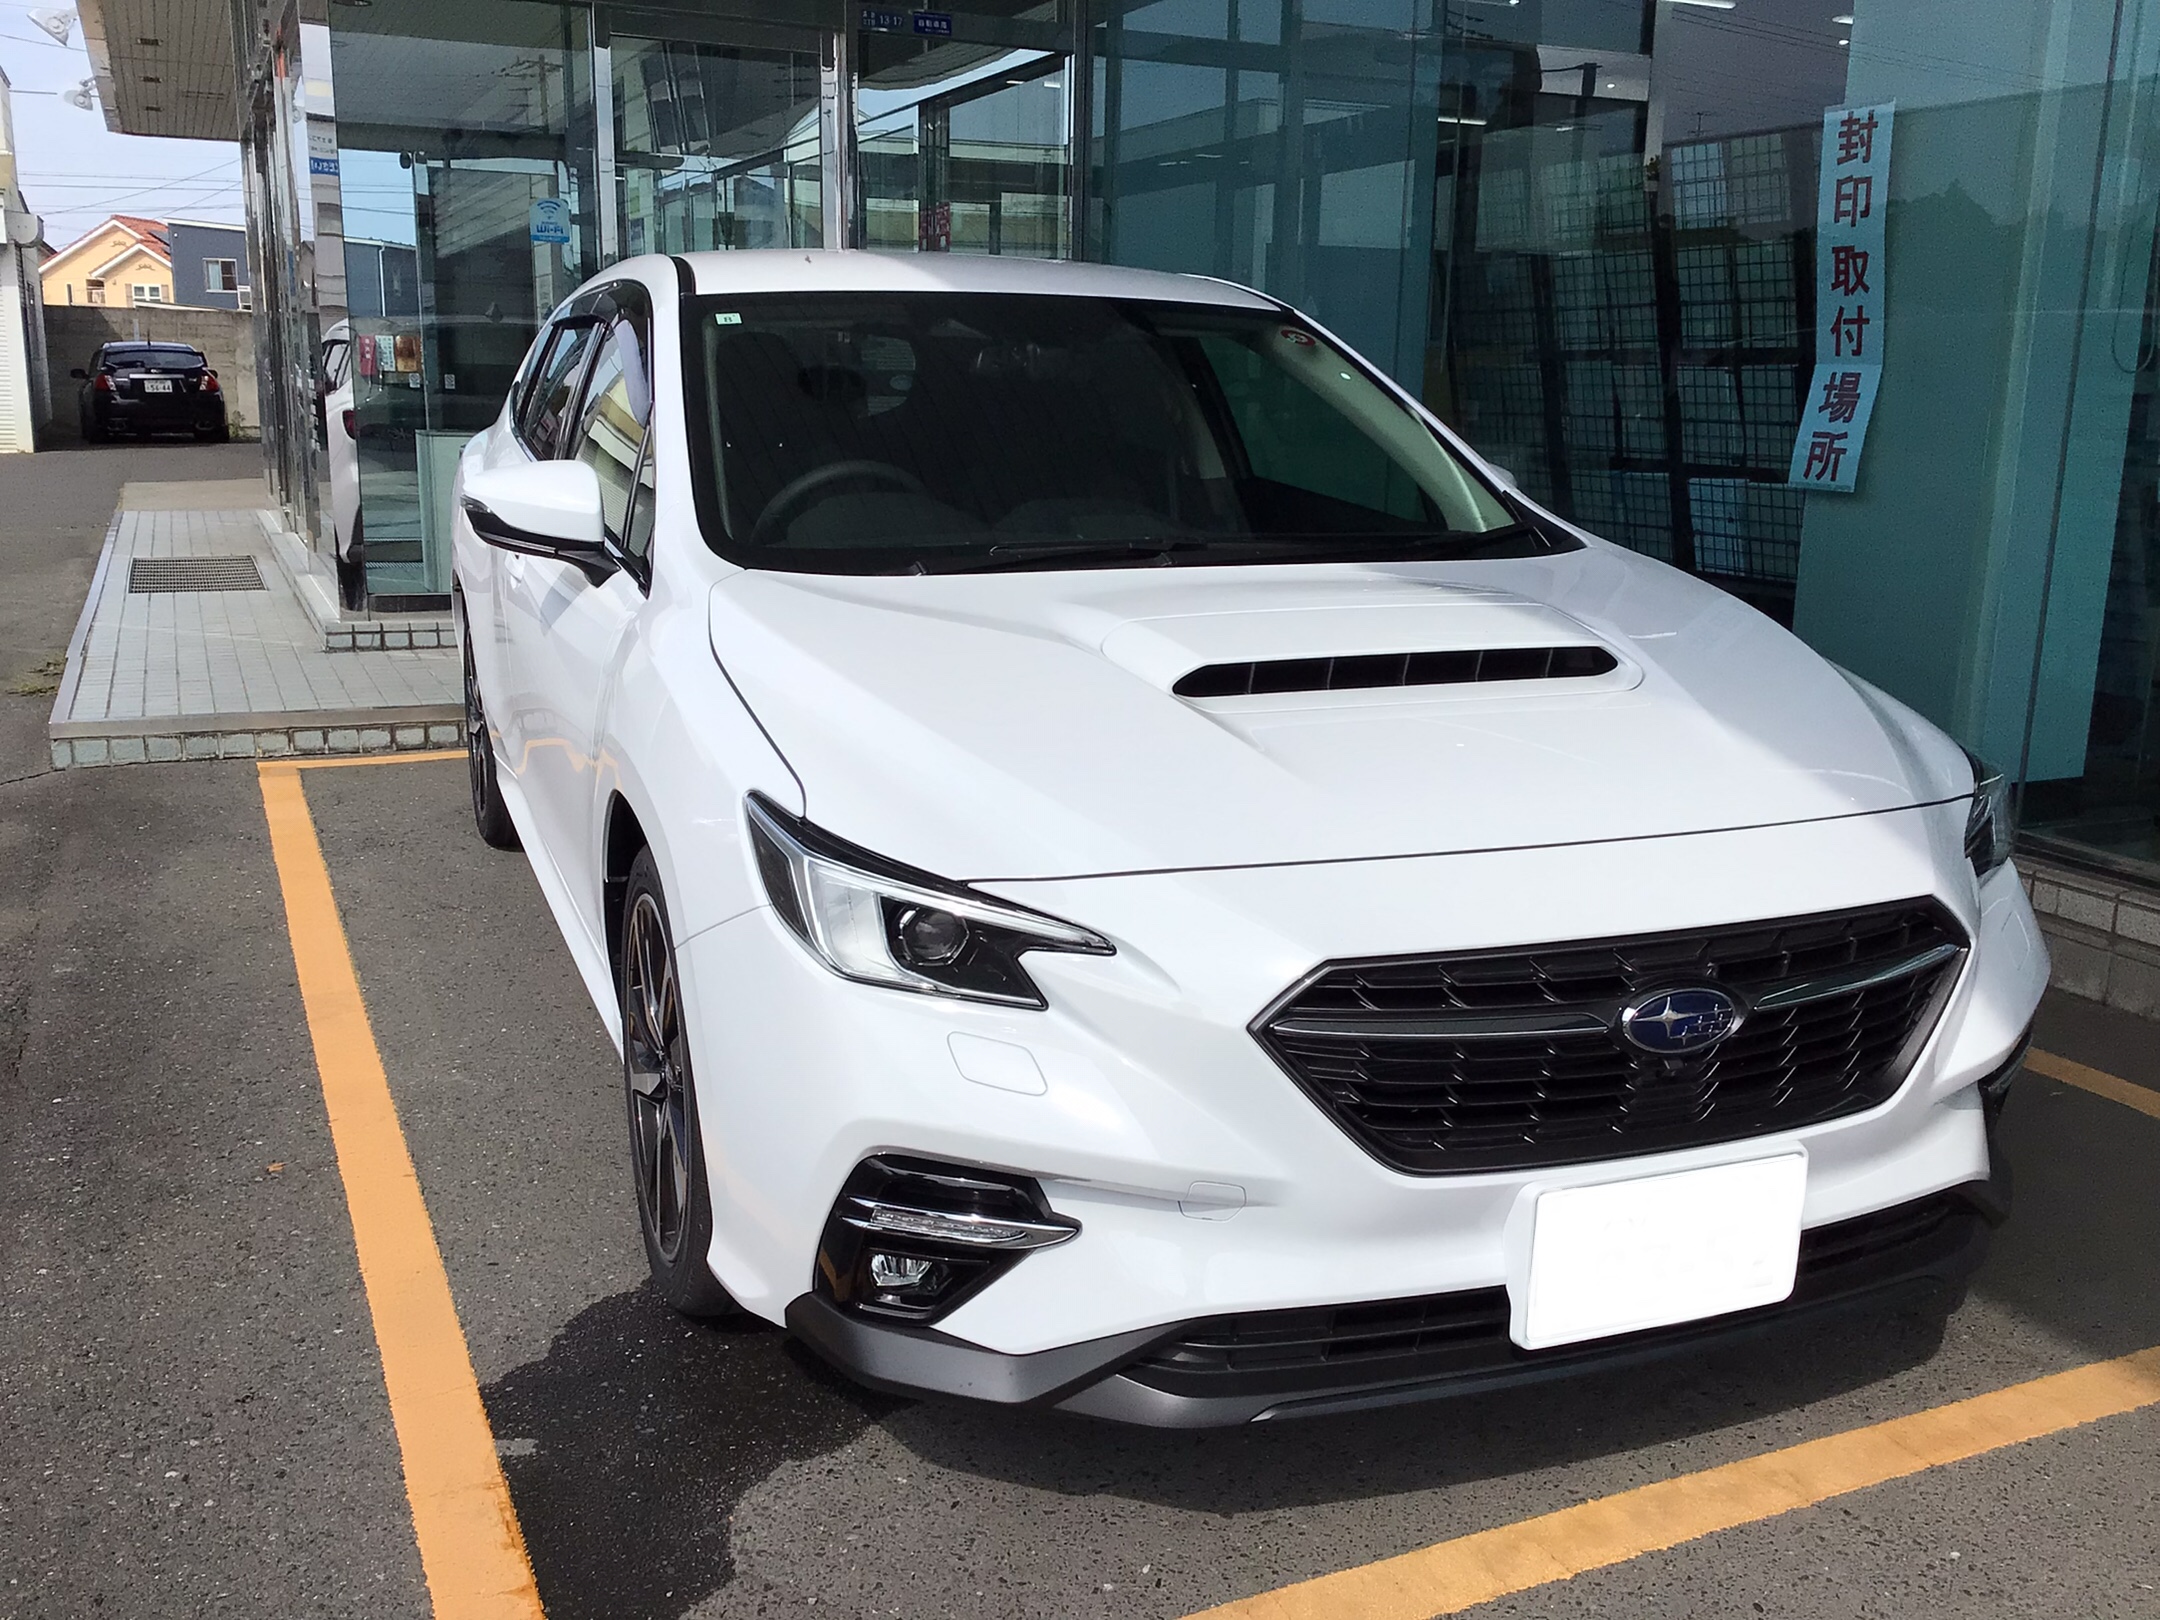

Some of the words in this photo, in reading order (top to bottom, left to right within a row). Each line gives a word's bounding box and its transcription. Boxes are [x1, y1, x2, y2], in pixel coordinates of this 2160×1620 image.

[1803, 109, 1879, 482] 封印取付場所
